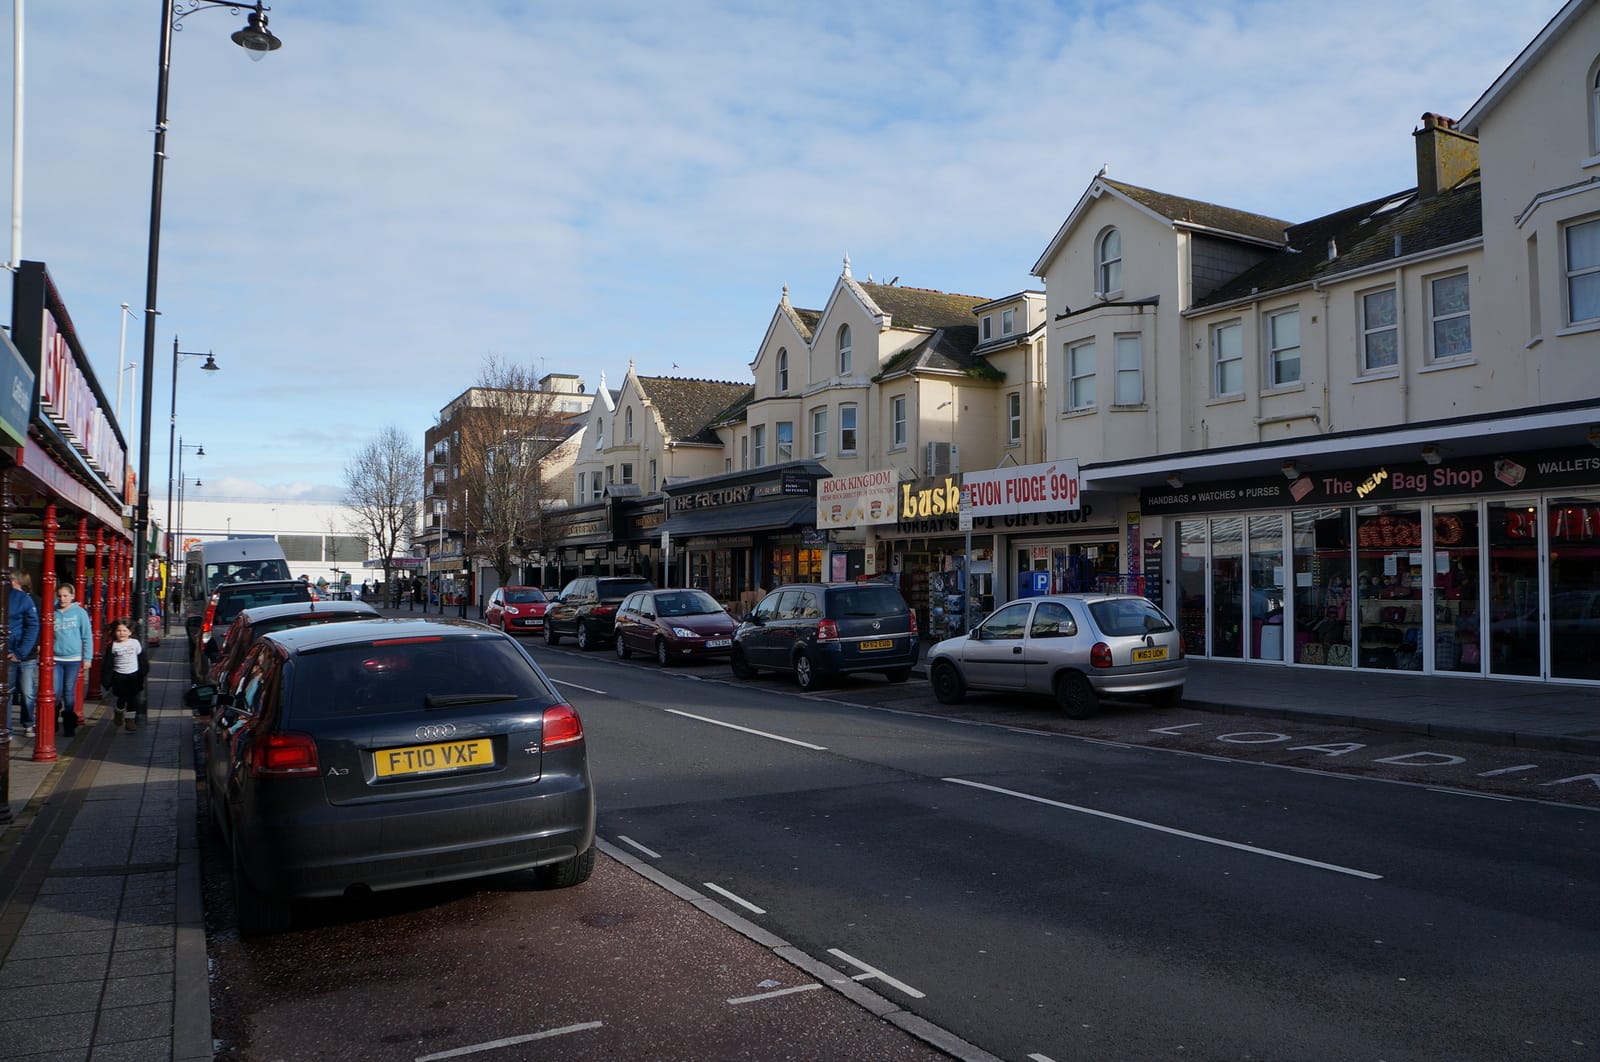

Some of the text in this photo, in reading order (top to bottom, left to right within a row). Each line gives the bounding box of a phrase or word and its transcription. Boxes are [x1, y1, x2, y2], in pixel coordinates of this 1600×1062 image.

[1537, 457, 1600, 475] WALLETS
[823, 478, 847, 493] ROCK
[848, 471, 891, 490] KINGDOM
[1005, 475, 1047, 505] FUDGE
[1050, 473, 1078, 505] 99p
[1322, 466, 1483, 499] The NEW Bag Shop
[673, 495, 693, 510] THE
[1148, 486, 1280, 505] HANDBAGS WATCHES PURSES
[1037, 575, 1047, 589] P
[388, 743, 479, 772] FT10 VXF
[327, 766, 350, 777] A3
